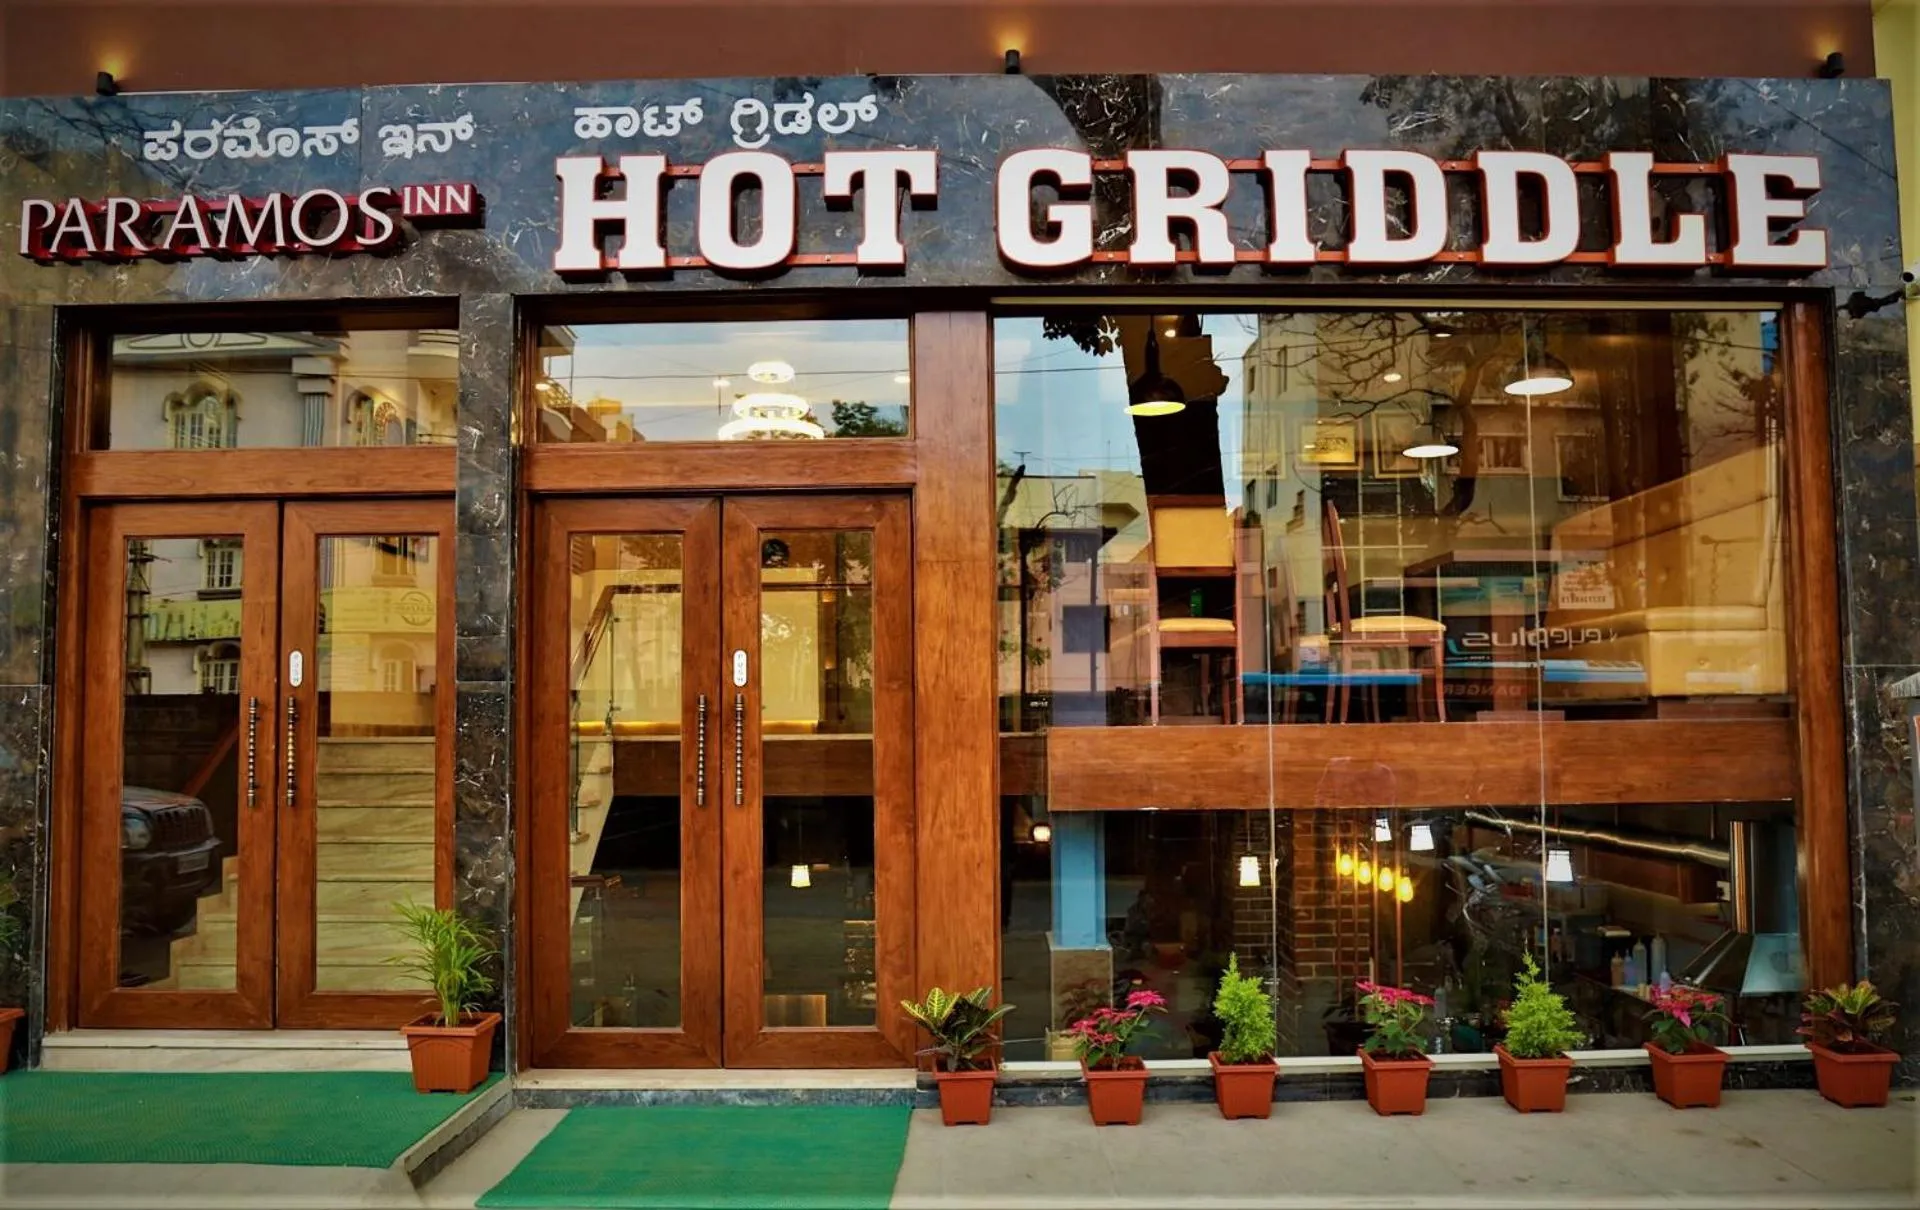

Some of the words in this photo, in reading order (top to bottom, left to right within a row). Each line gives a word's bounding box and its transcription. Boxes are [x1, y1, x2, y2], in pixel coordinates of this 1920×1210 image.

[378, 112, 474, 159] ಇನ್
[574, 97, 703, 139] ಹಾಟ್
[19, 186, 396, 256] PARAMOS
[402, 184, 473, 214] INN
[554, 149, 937, 272] HOT
[996, 147, 1828, 268] GRIDDLE
